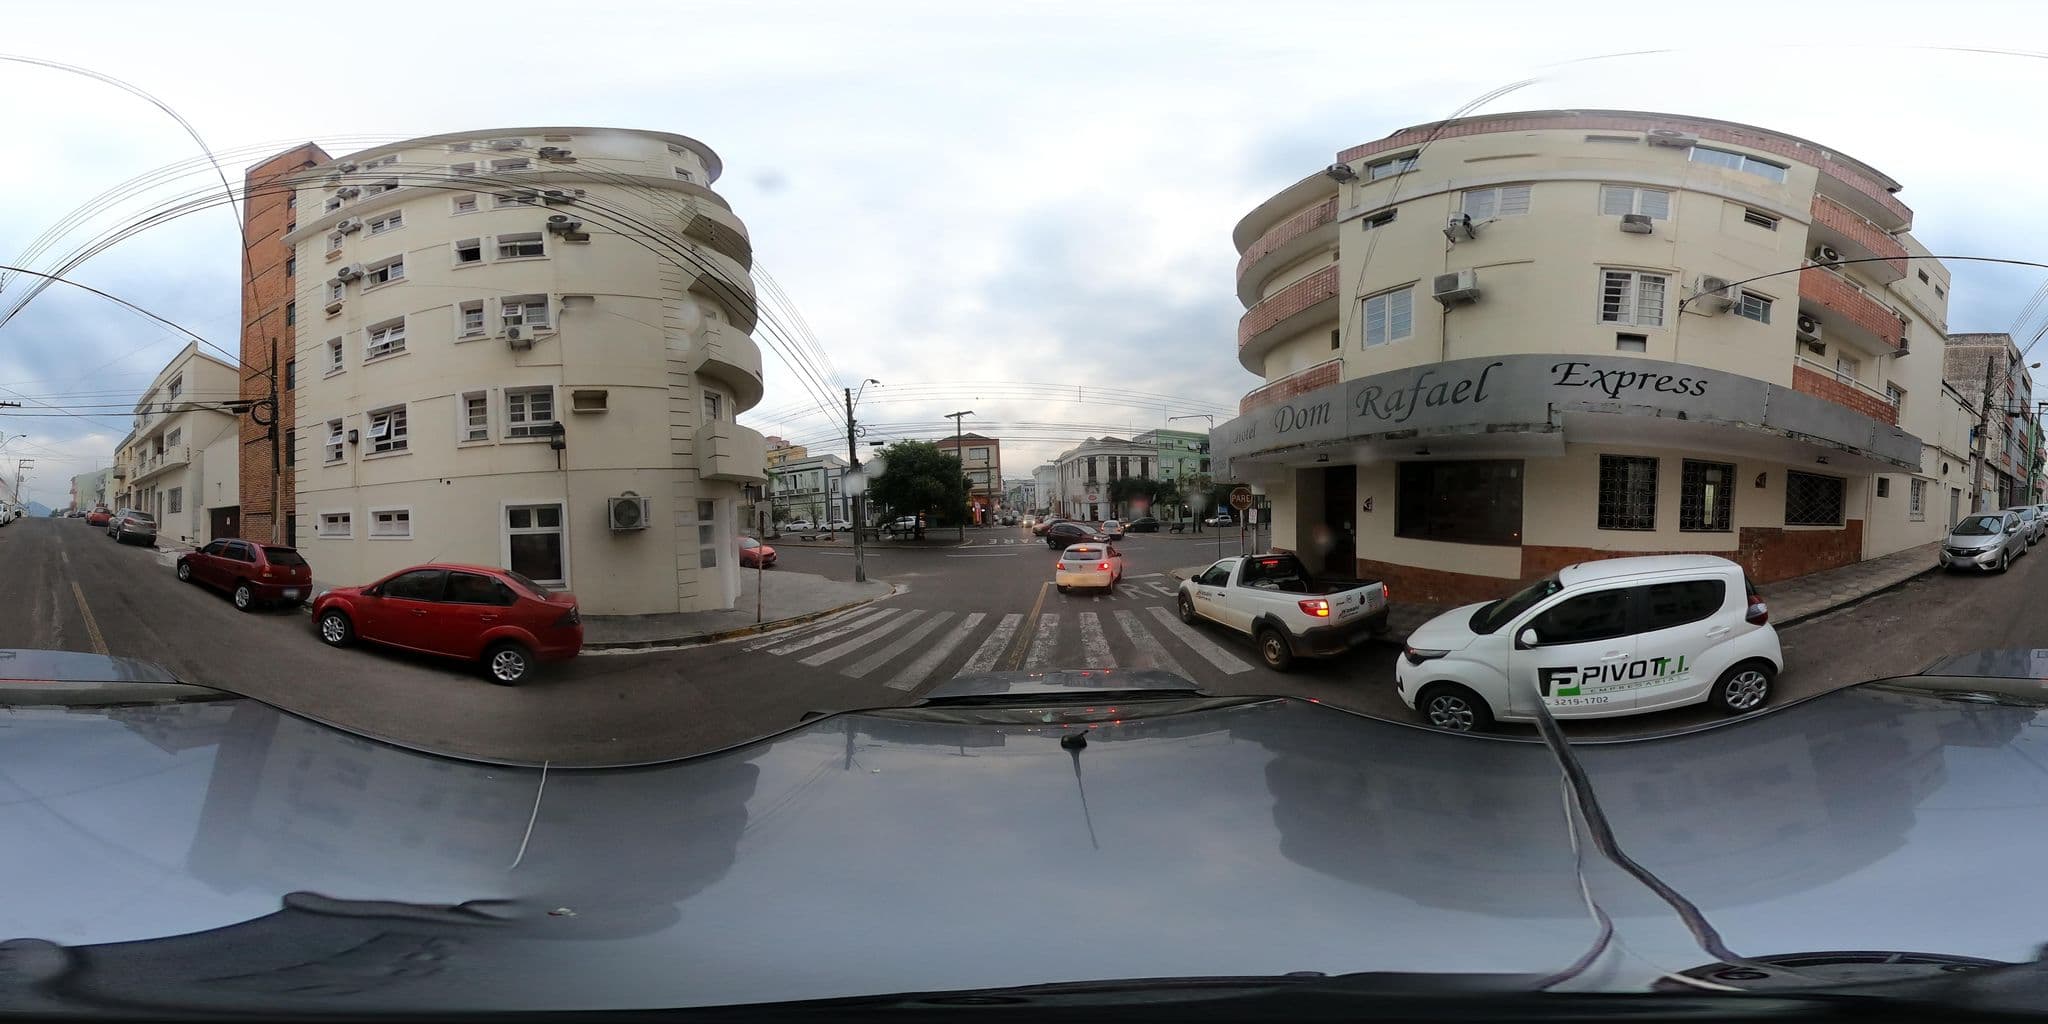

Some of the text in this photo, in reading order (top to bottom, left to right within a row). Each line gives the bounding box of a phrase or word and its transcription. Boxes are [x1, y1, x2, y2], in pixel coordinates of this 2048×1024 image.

[1274, 401, 1332, 433] Dom
[1355, 362, 1503, 423] Rafael
[1551, 362, 1708, 399] Express
[1231, 495, 1251, 503] PARE
[1555, 696, 1609, 706] 3219-1702
